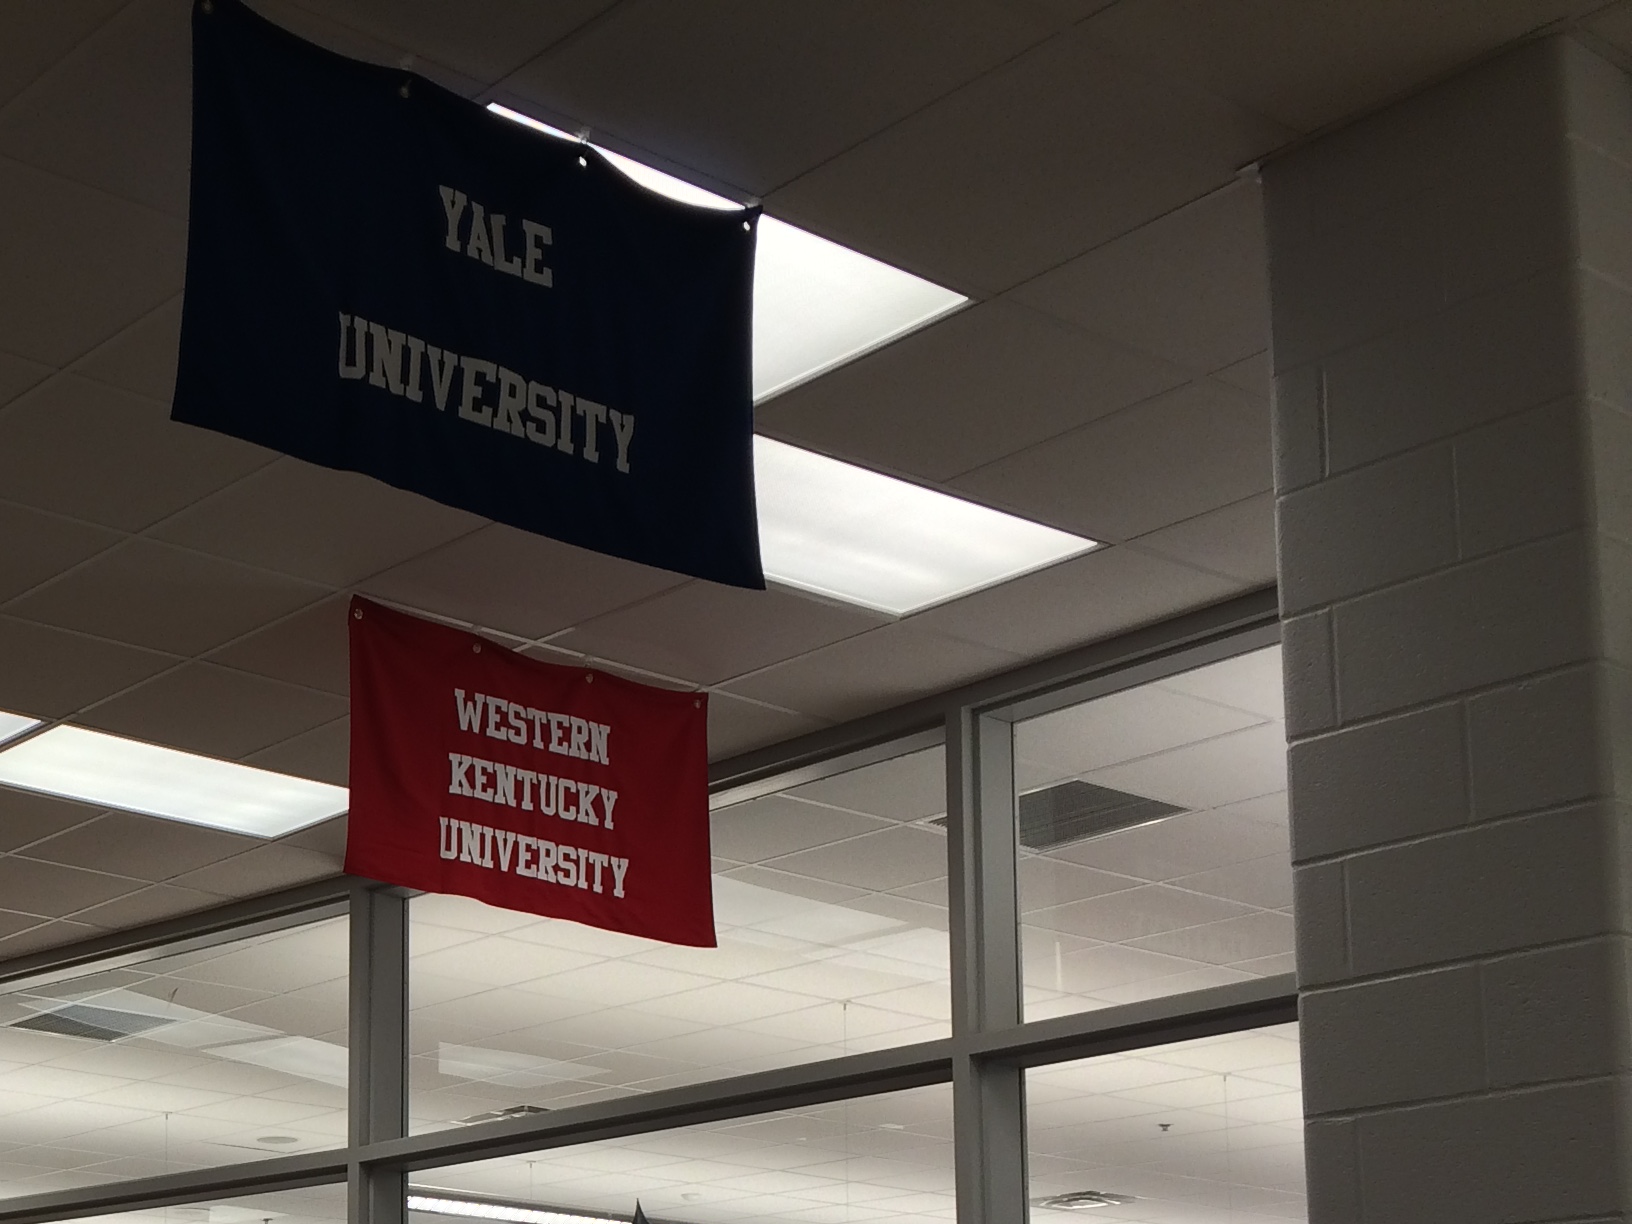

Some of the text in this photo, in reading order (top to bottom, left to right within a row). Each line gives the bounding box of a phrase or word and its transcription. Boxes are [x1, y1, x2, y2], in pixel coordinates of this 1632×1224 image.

[439, 184, 553, 288] YALE
[337, 311, 635, 474] UNIVERSITY
[454, 688, 611, 765] WESTERN
[448, 752, 618, 830] KENTUCKY
[439, 816, 629, 899] UNIVERSITY
